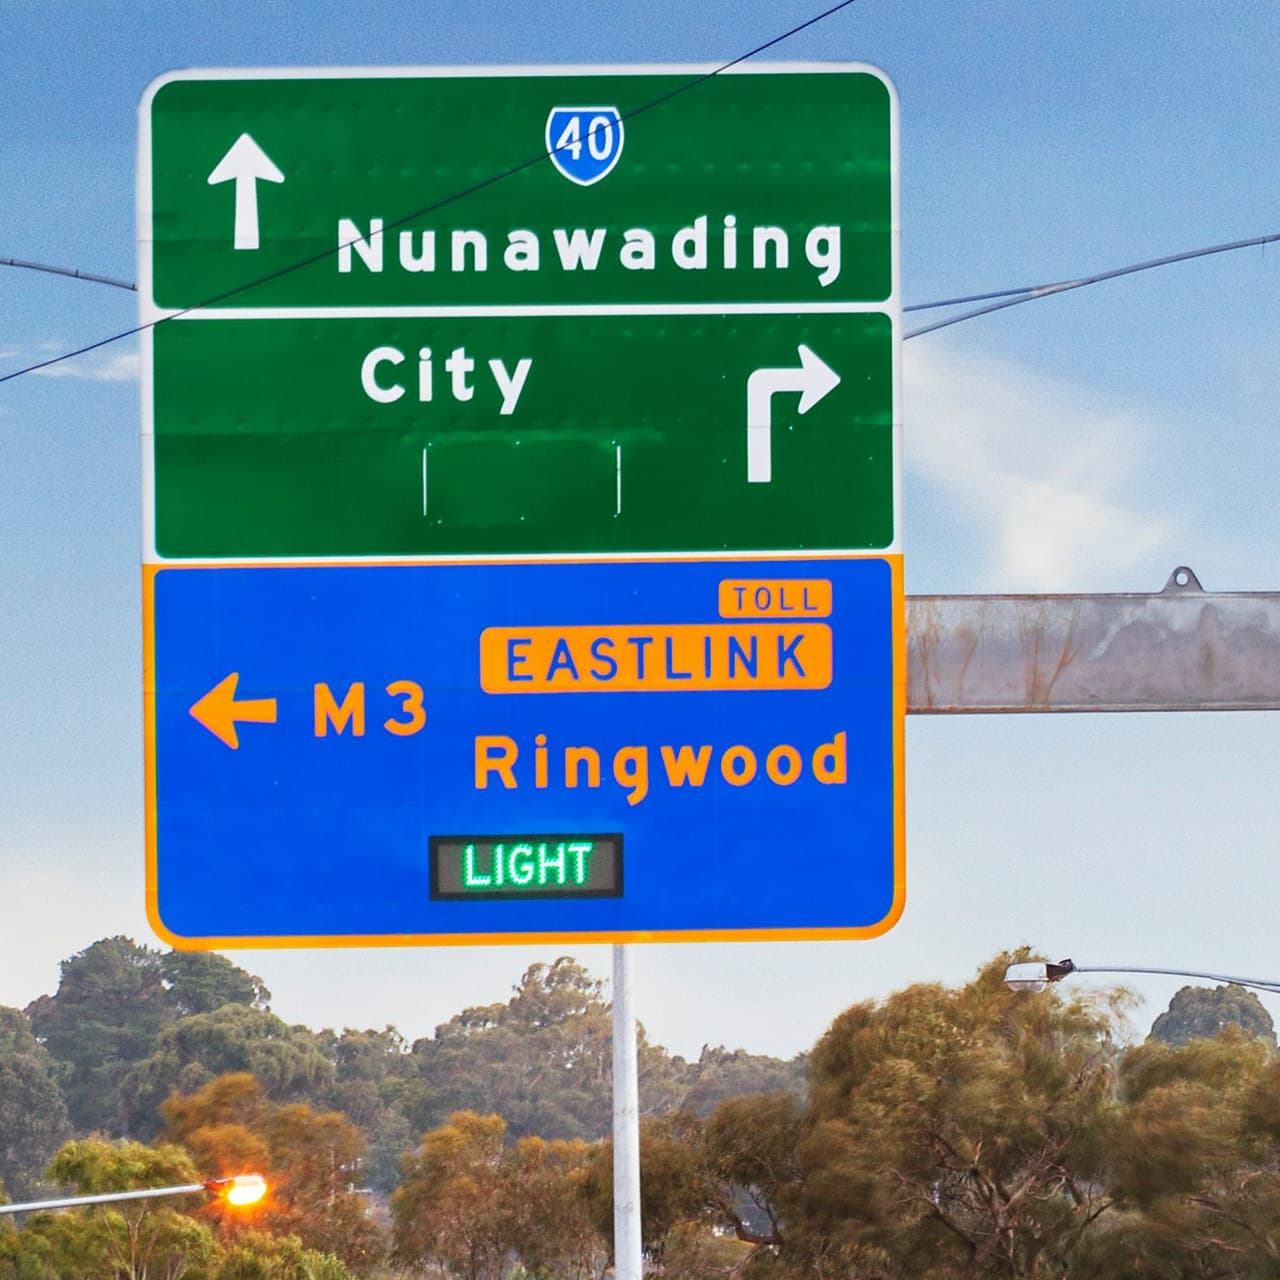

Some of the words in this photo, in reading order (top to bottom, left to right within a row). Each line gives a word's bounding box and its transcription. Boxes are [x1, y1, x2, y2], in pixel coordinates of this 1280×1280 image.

[555, 116, 613, 161] 40
[337, 213, 842, 288] Nunawading
[360, 345, 534, 416] City
[732, 585, 819, 613] TOLL
[505, 633, 808, 684] EASTLINK
[473, 730, 849, 807] Ringwood
[462, 841, 594, 889] LIGHT
